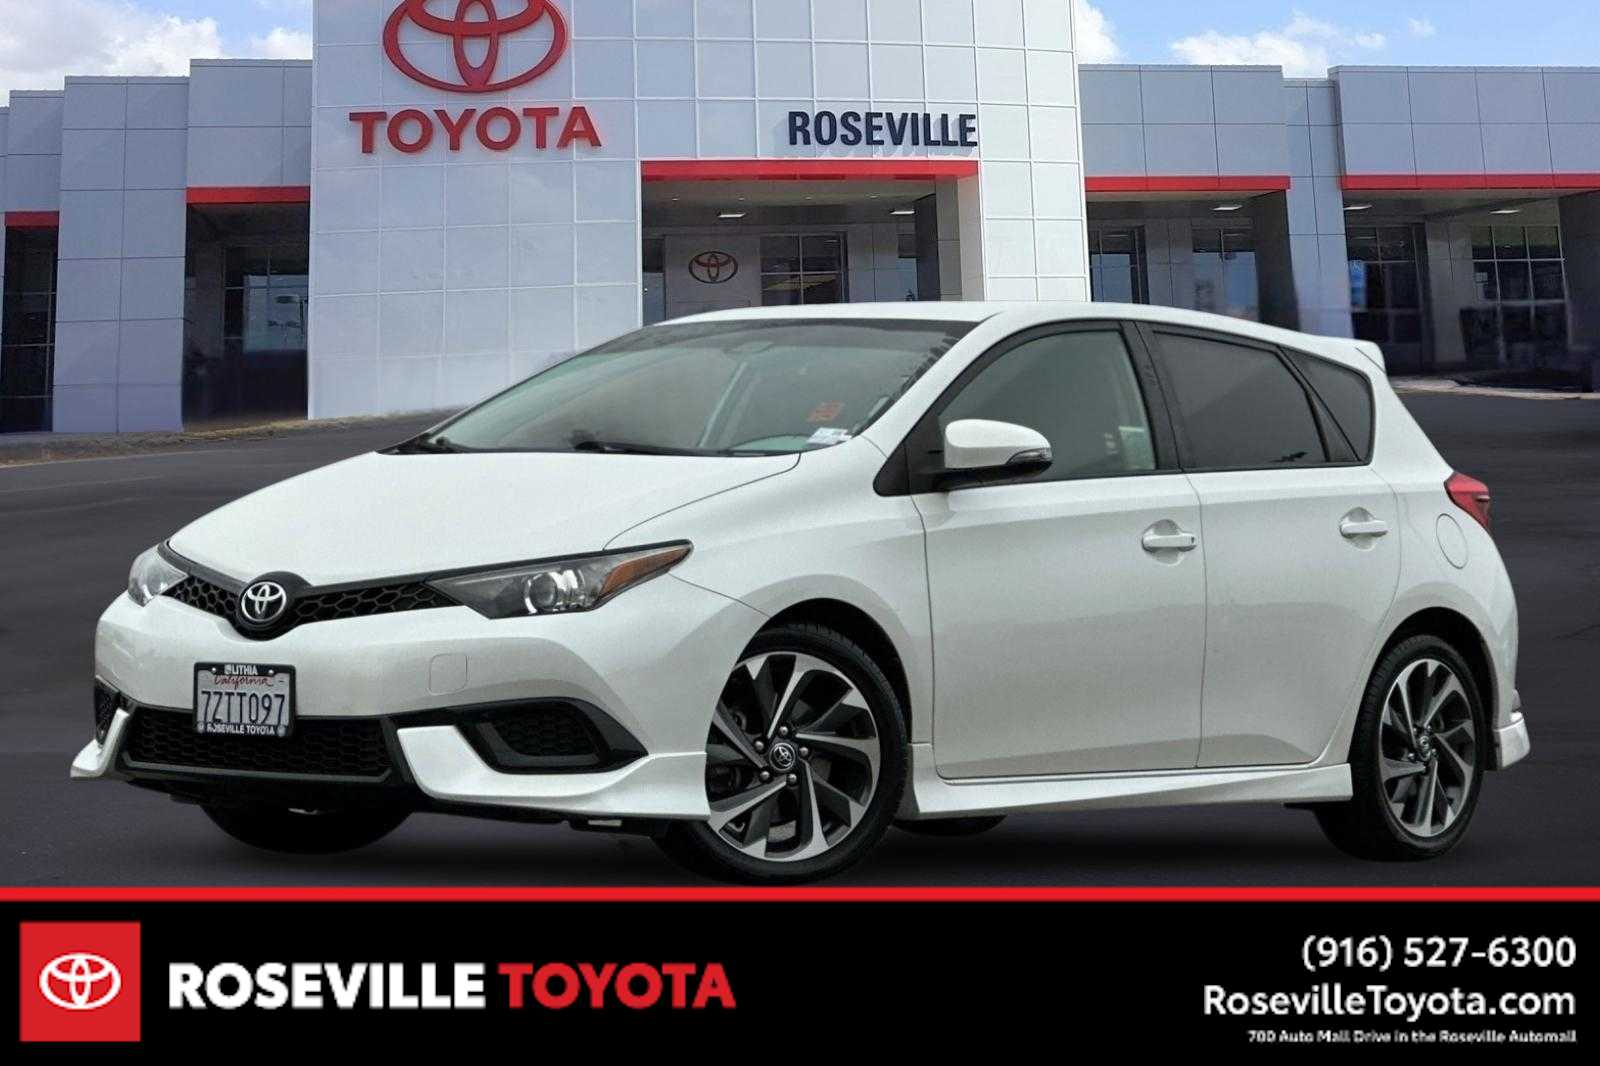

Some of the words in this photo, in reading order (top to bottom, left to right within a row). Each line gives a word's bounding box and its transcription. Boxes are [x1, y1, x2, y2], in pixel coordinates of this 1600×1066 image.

[349, 106, 602, 154] TOYOTA
[788, 111, 978, 147] ROSEVILLE
[232, 664, 258, 675] LITHIA
[201, 690, 285, 725] 7ZTT097
[207, 723, 244, 734] ROSEVILLE
[246, 725, 275, 735] TOYOTA
